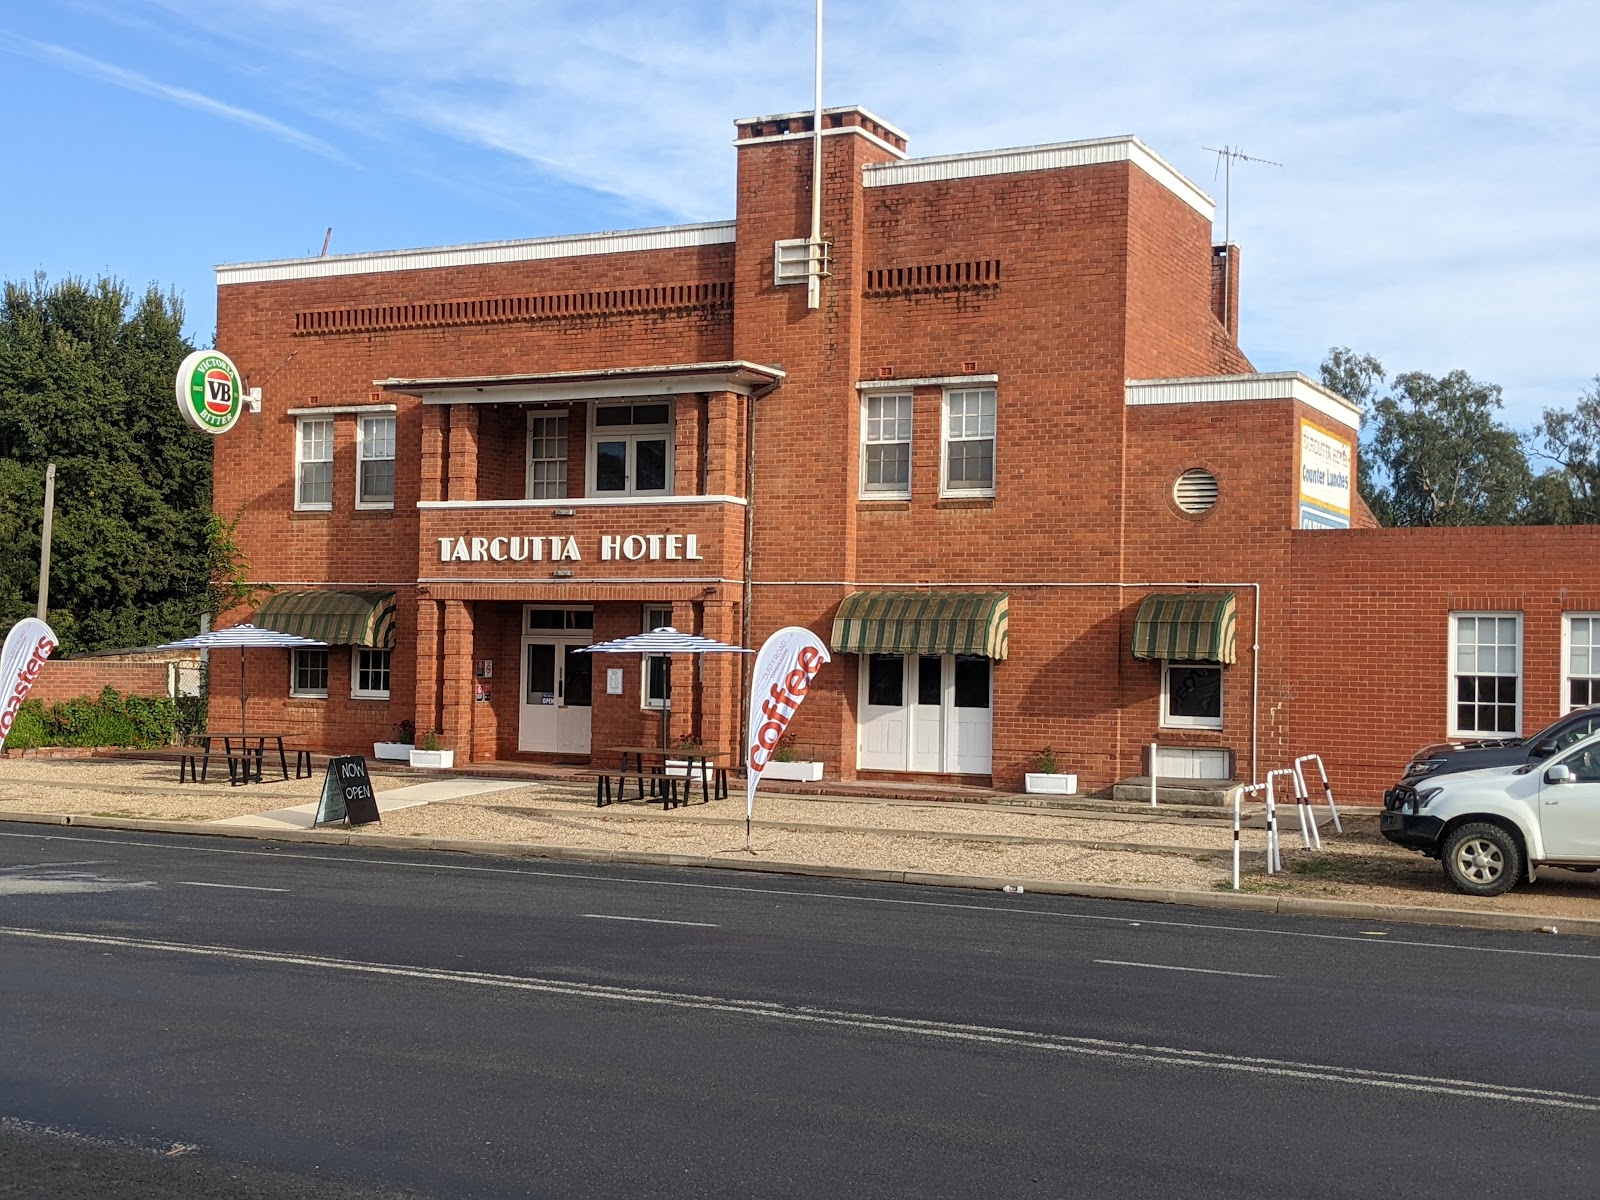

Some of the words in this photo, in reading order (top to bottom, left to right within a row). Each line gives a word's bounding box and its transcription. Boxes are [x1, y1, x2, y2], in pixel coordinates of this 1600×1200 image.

[198, 359, 234, 379] VICTORIA
[207, 381, 231, 402] VB
[200, 409, 232, 425] BITTER
[1303, 464, 1325, 486] Counter
[1327, 469, 1348, 489] Lunches
[438, 535, 582, 561] TARCUTTA
[600, 534, 703, 560] HOTEL
[762, 658, 776, 680] DUSTY
[773, 640, 787, 661] ROAD
[751, 646, 824, 772] coffee
[342, 762, 364, 778] NOW
[346, 785, 370, 799] OPEN
